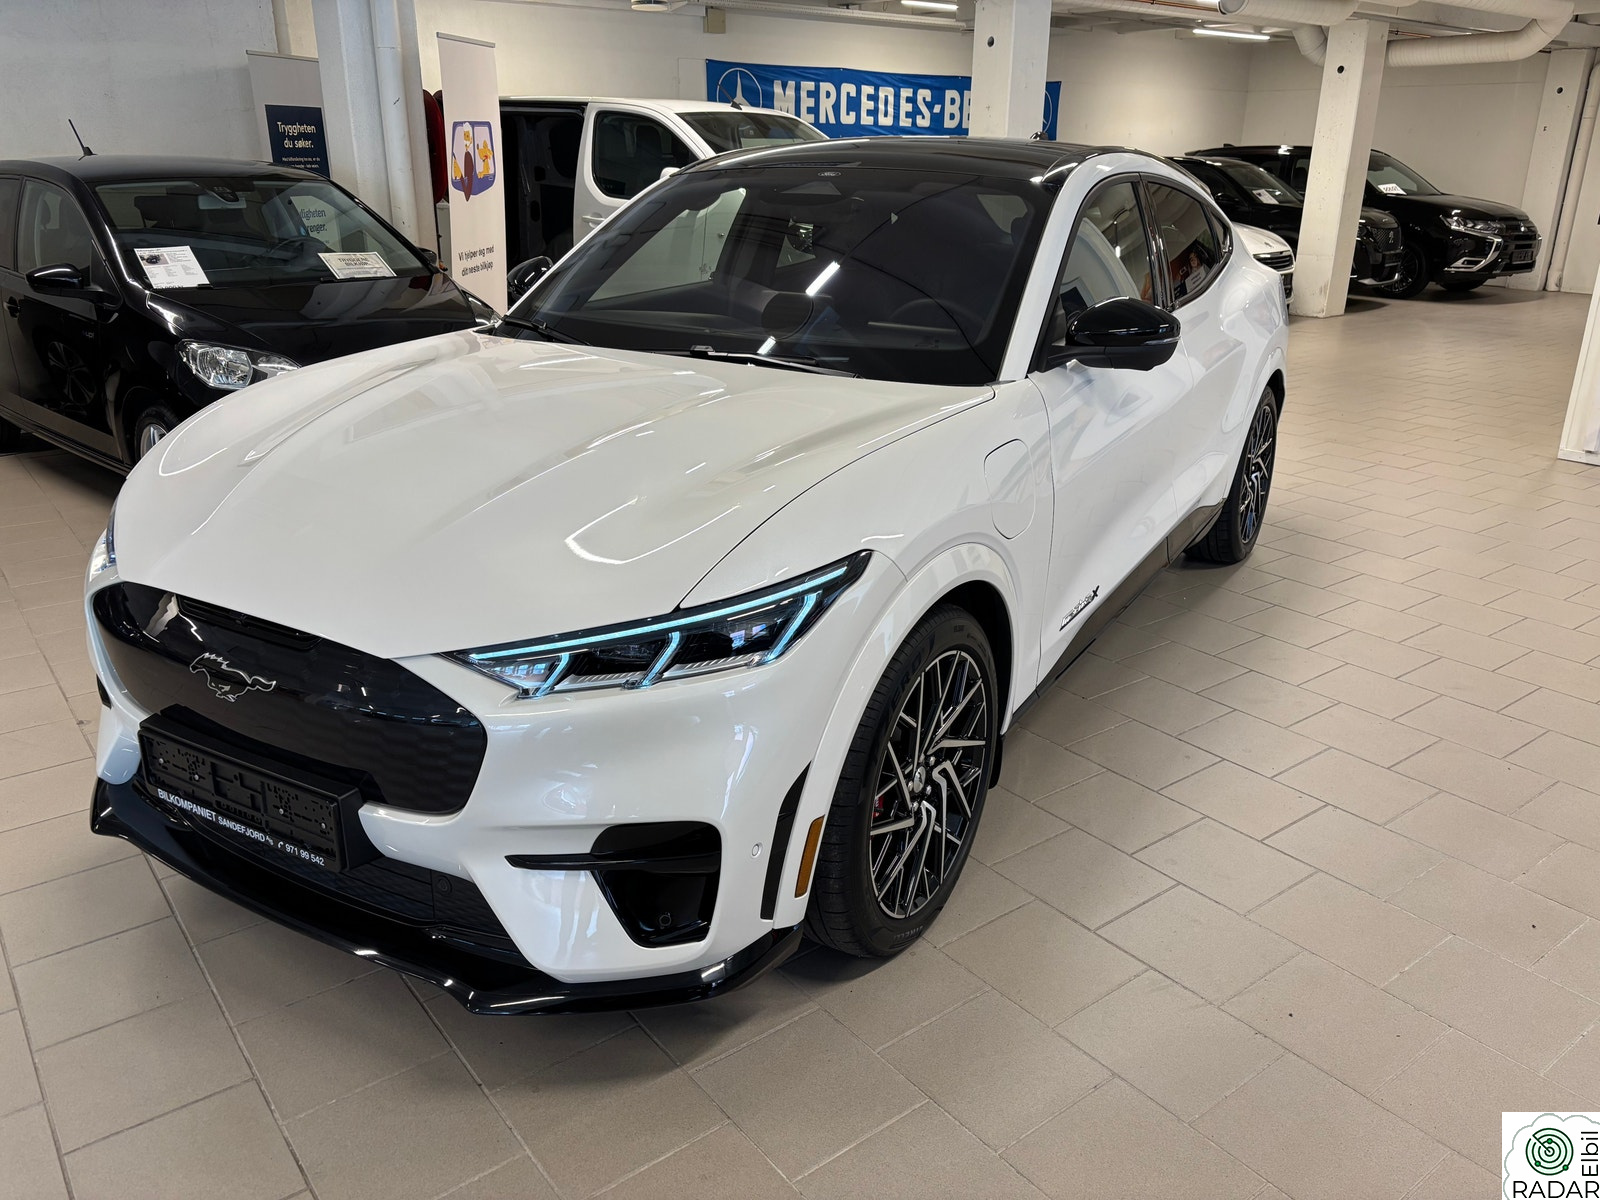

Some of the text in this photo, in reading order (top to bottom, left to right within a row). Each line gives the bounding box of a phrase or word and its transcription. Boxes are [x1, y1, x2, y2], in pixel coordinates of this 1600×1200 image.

[773, 80, 970, 129] MERCEDES-BE
[277, 121, 317, 136] Tryggheten
[283, 137, 314, 148] du søker.
[307, 224, 328, 233] renger.
[458, 252, 464, 261] Vi
[486, 244, 494, 254] med
[157, 788, 216, 822] BILKOMPANIET
[218, 815, 266, 842] SANDEFJORD
[285, 843, 298, 855] 971
[300, 849, 310, 860] 99
[310, 854, 325, 866] 542
